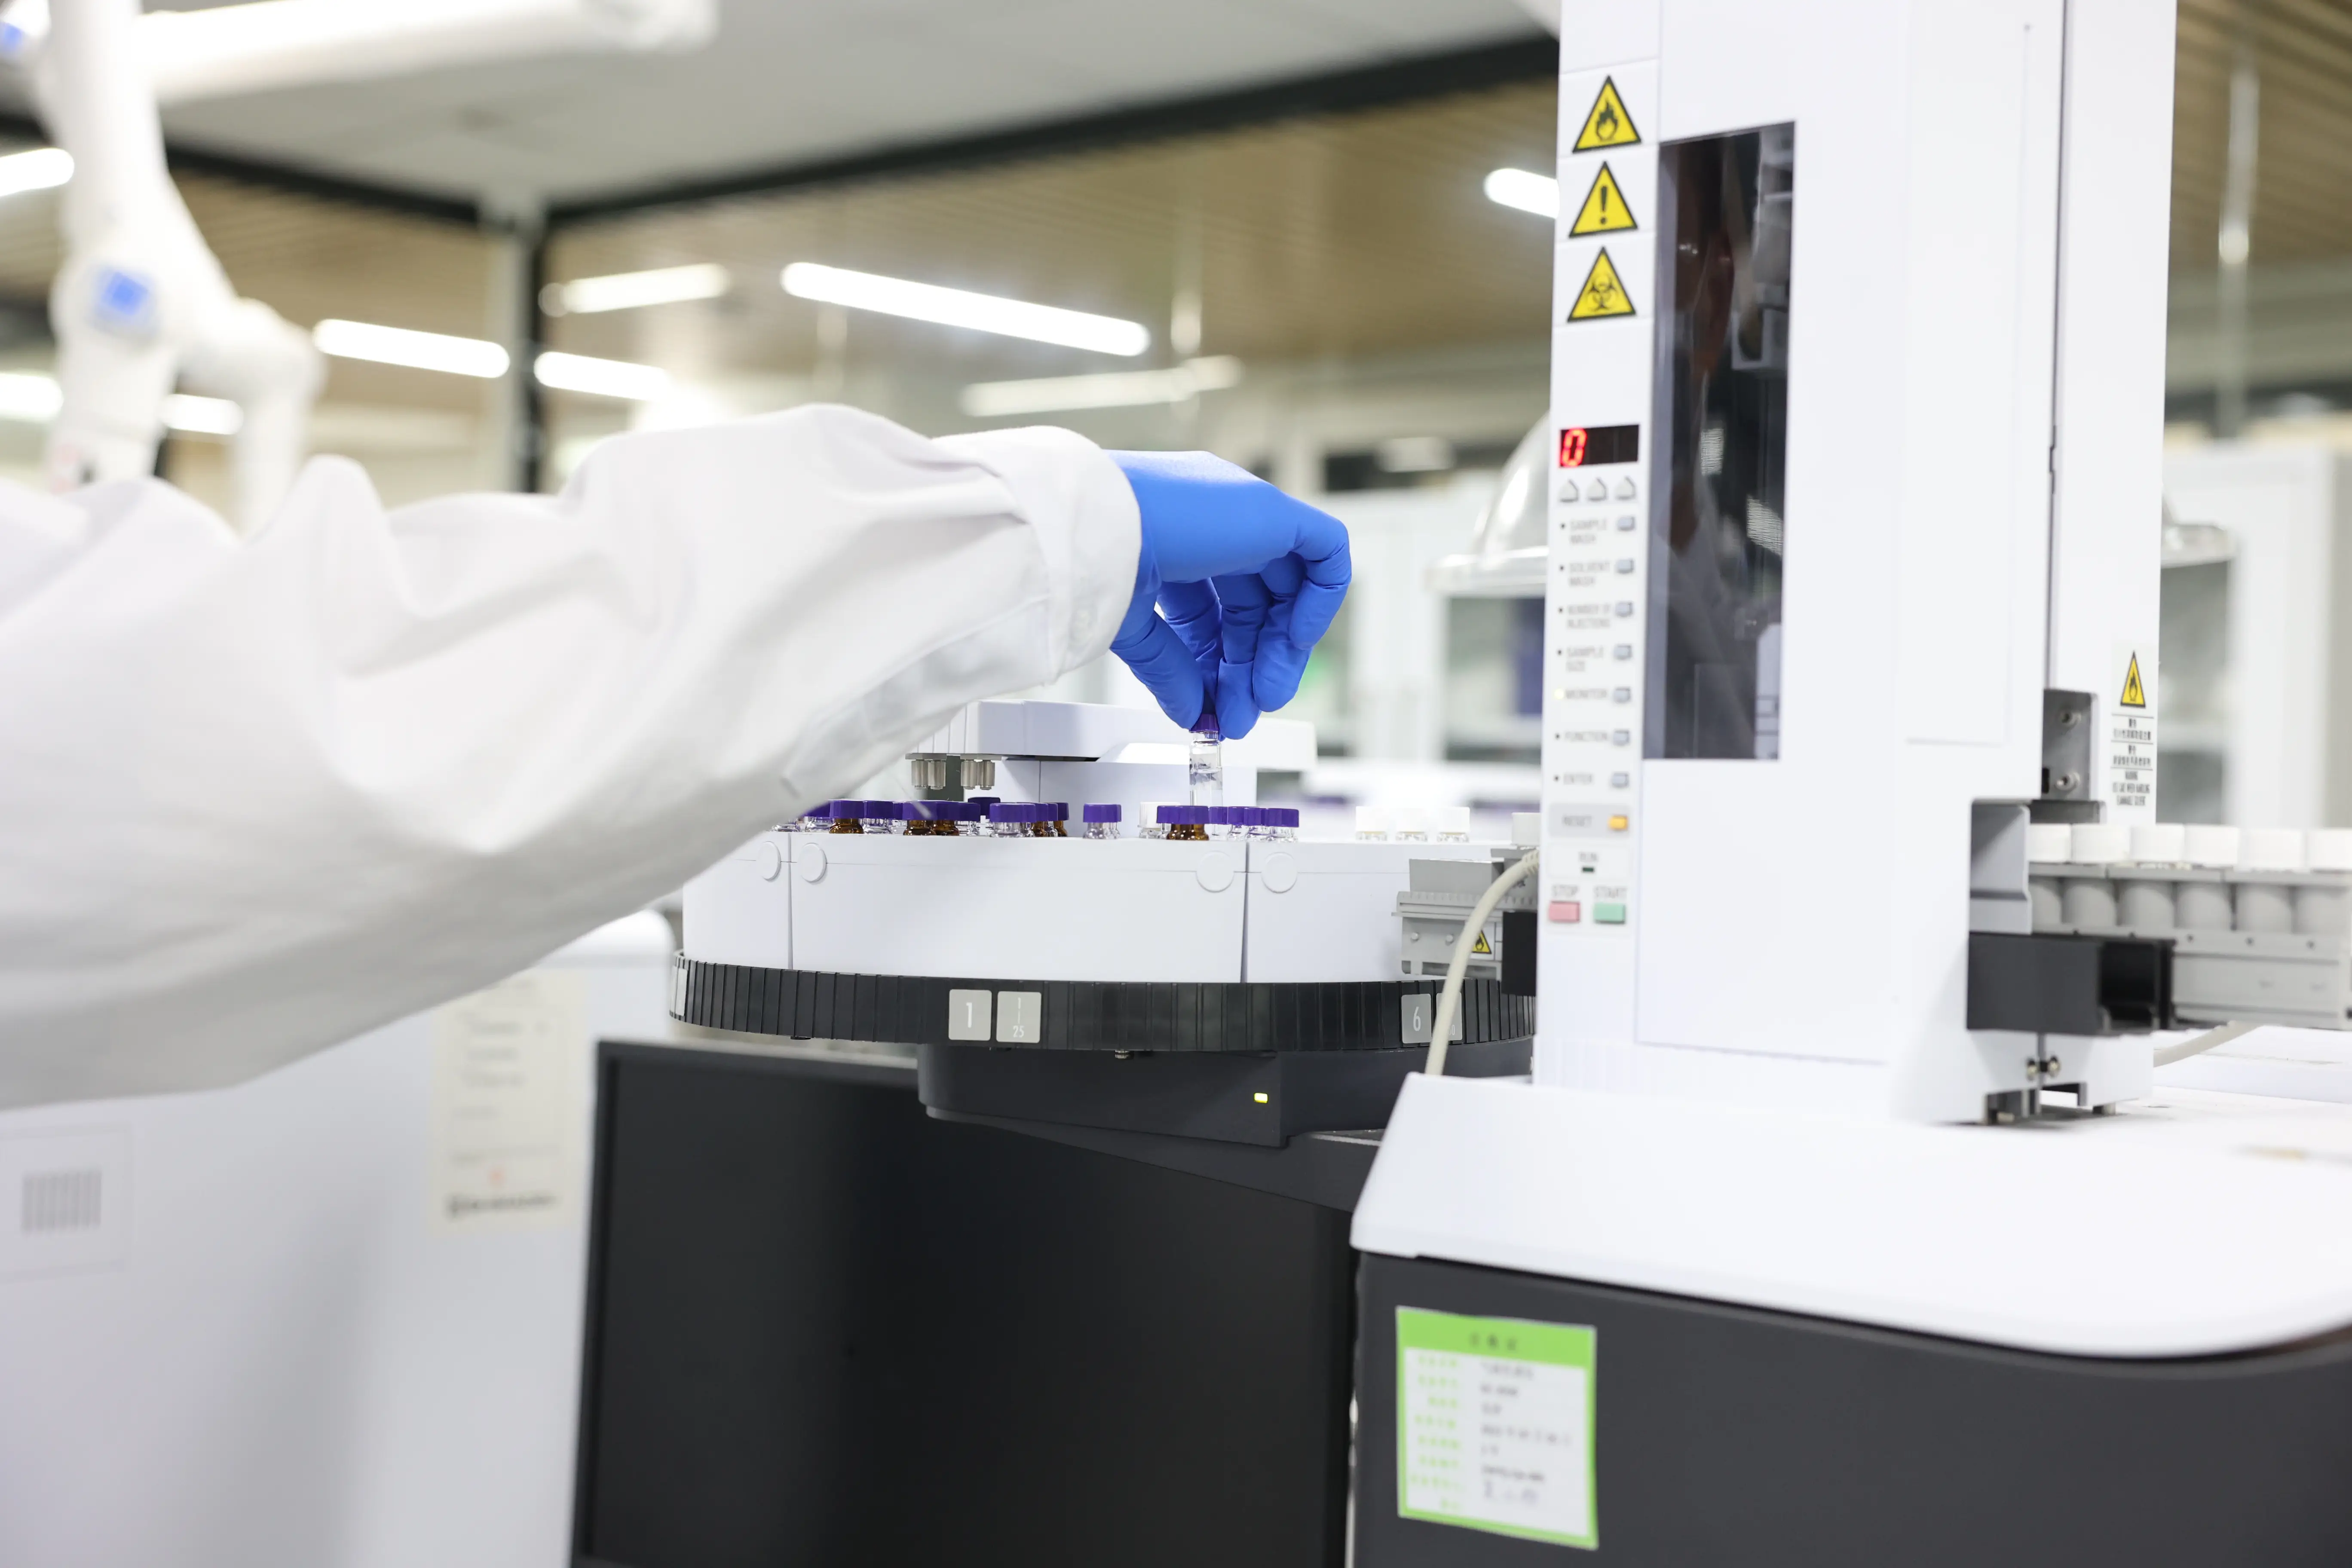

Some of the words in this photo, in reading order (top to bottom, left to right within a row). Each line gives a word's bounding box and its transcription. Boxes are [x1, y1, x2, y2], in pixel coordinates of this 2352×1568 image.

[1560, 428, 1587, 467] 0
[1552, 885, 1579, 897] STOP
[1594, 886, 1627, 898] START
[1017, 997, 1021, 1009] 1
[966, 1002, 972, 1028] 1
[1413, 1007, 1421, 1031] 6
[1013, 1025, 1024, 1038] 25
